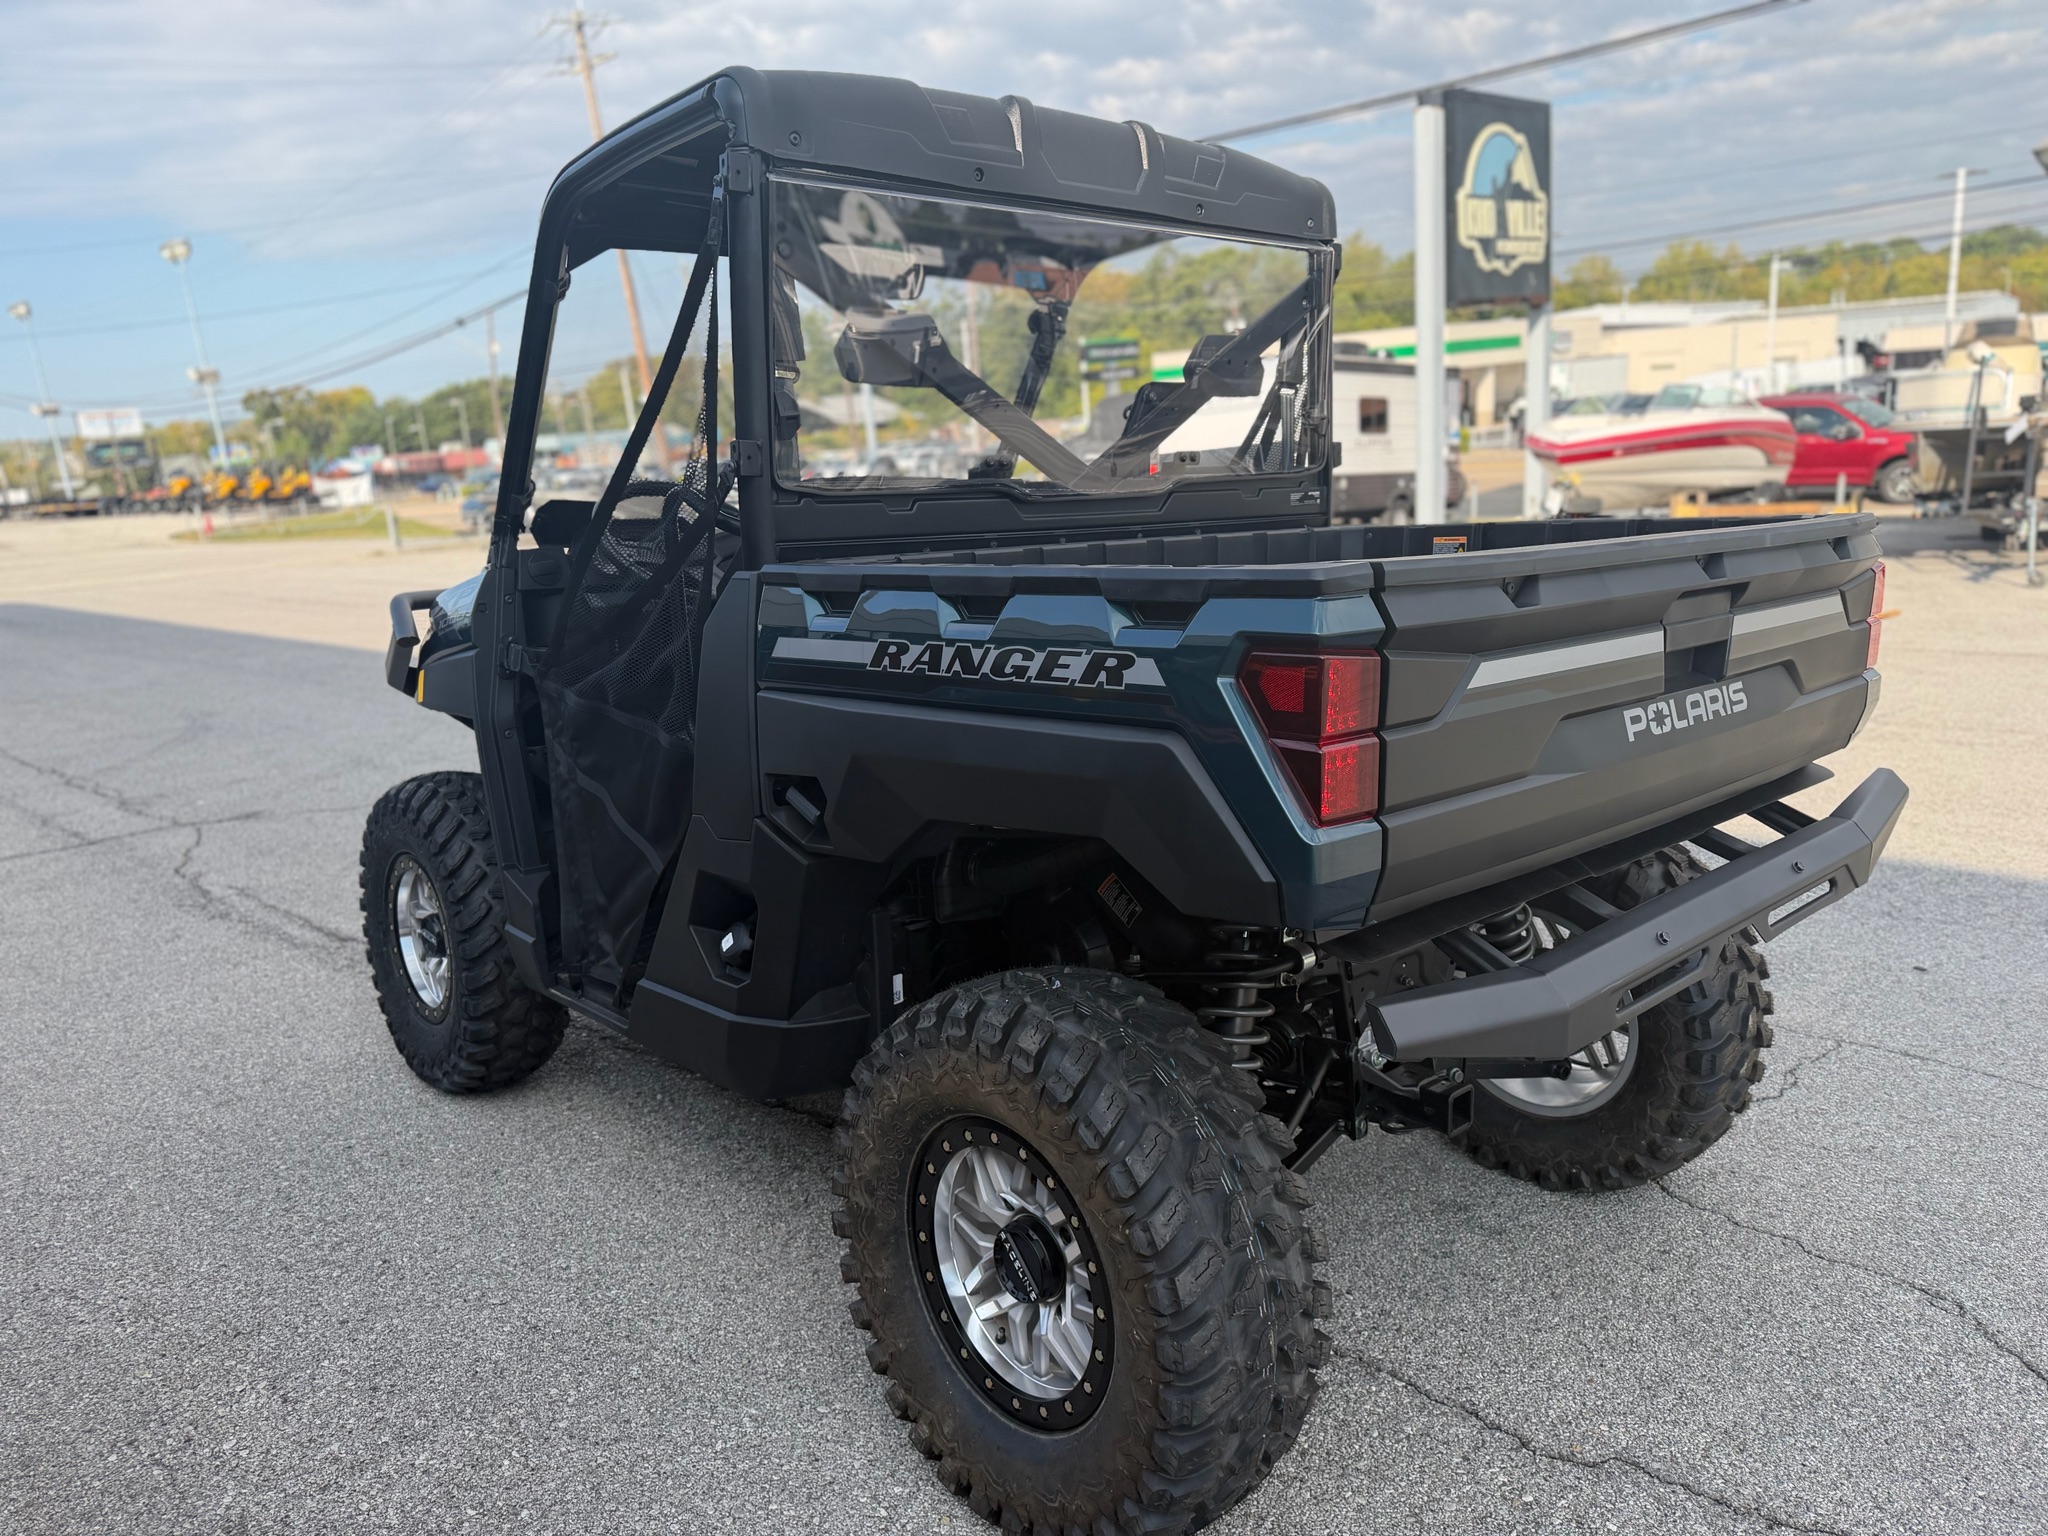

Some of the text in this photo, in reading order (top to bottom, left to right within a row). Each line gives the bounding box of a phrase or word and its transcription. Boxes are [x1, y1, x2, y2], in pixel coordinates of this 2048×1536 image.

[867, 639, 1137, 690] RANGER
[1623, 681, 1748, 742] POLARIS
[998, 1230, 1038, 1302] RACELINE
